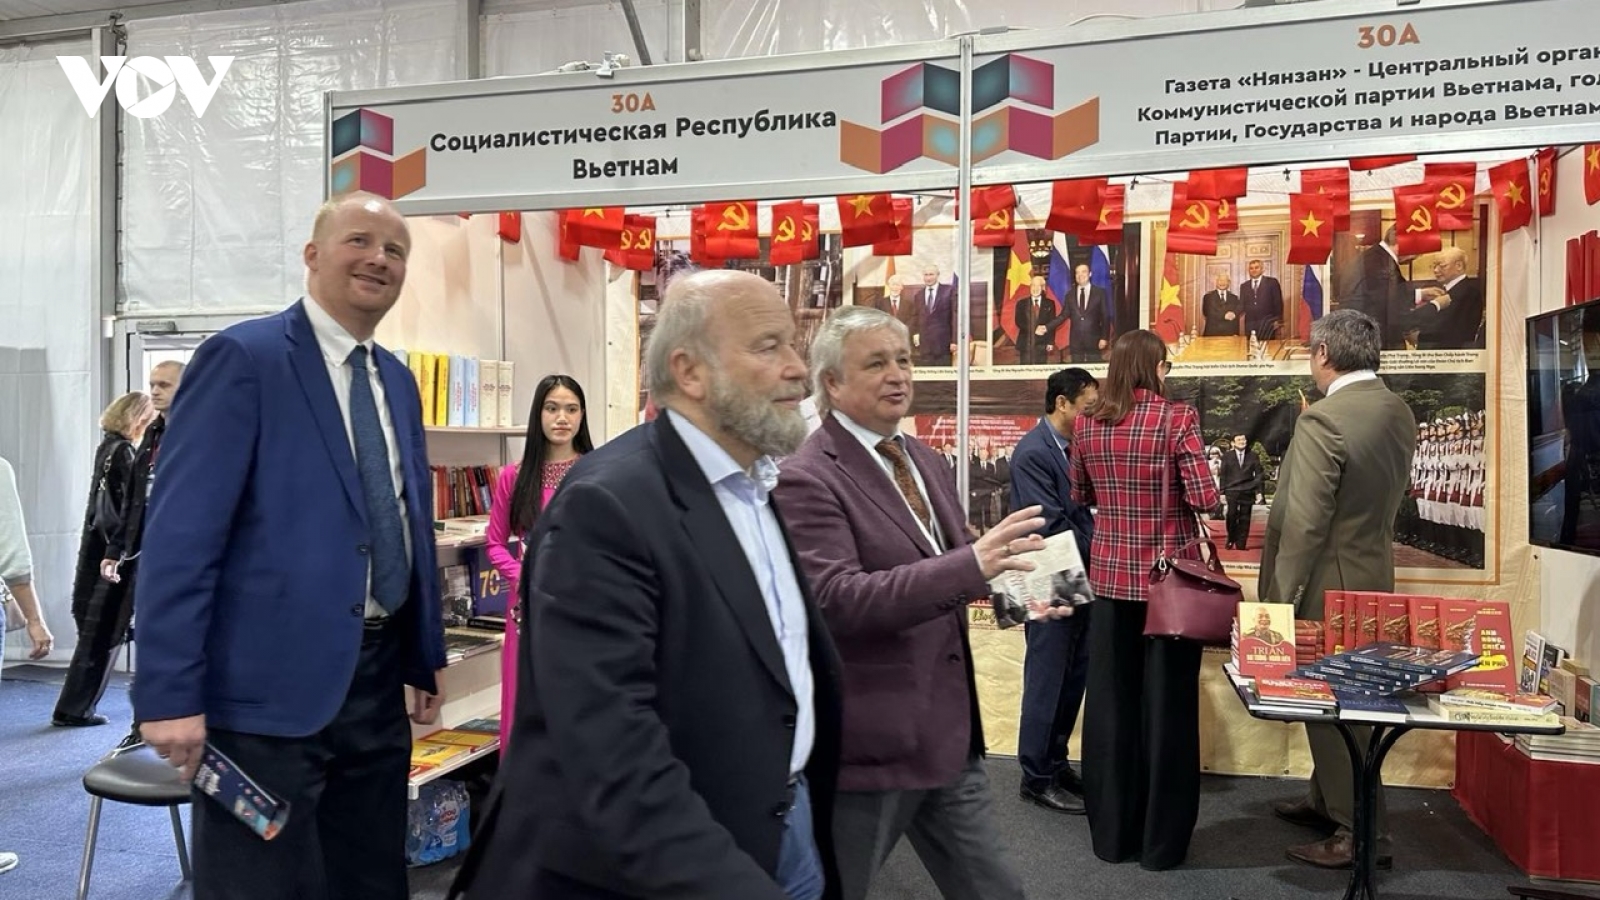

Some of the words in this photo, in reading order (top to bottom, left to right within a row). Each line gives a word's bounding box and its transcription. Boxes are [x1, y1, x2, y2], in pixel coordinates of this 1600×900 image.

[1164, 77, 1231, 94] Газета
[1237, 67, 1347, 87] «Нянзан»
[1368, 47, 1529, 79] Центральный
[1137, 88, 1347, 122] Коммунистической
[1354, 86, 1435, 106] партии
[1443, 76, 1562, 97] Вьетнама,
[430, 122, 667, 153] Социалистическая
[676, 109, 837, 138] Республика
[1155, 127, 1237, 146] Партии,
[1245, 116, 1382, 140] Государства
[1389, 115, 1403, 128] и
[1410, 107, 1496, 128] народа
[573, 157, 678, 179] Вьетнам
